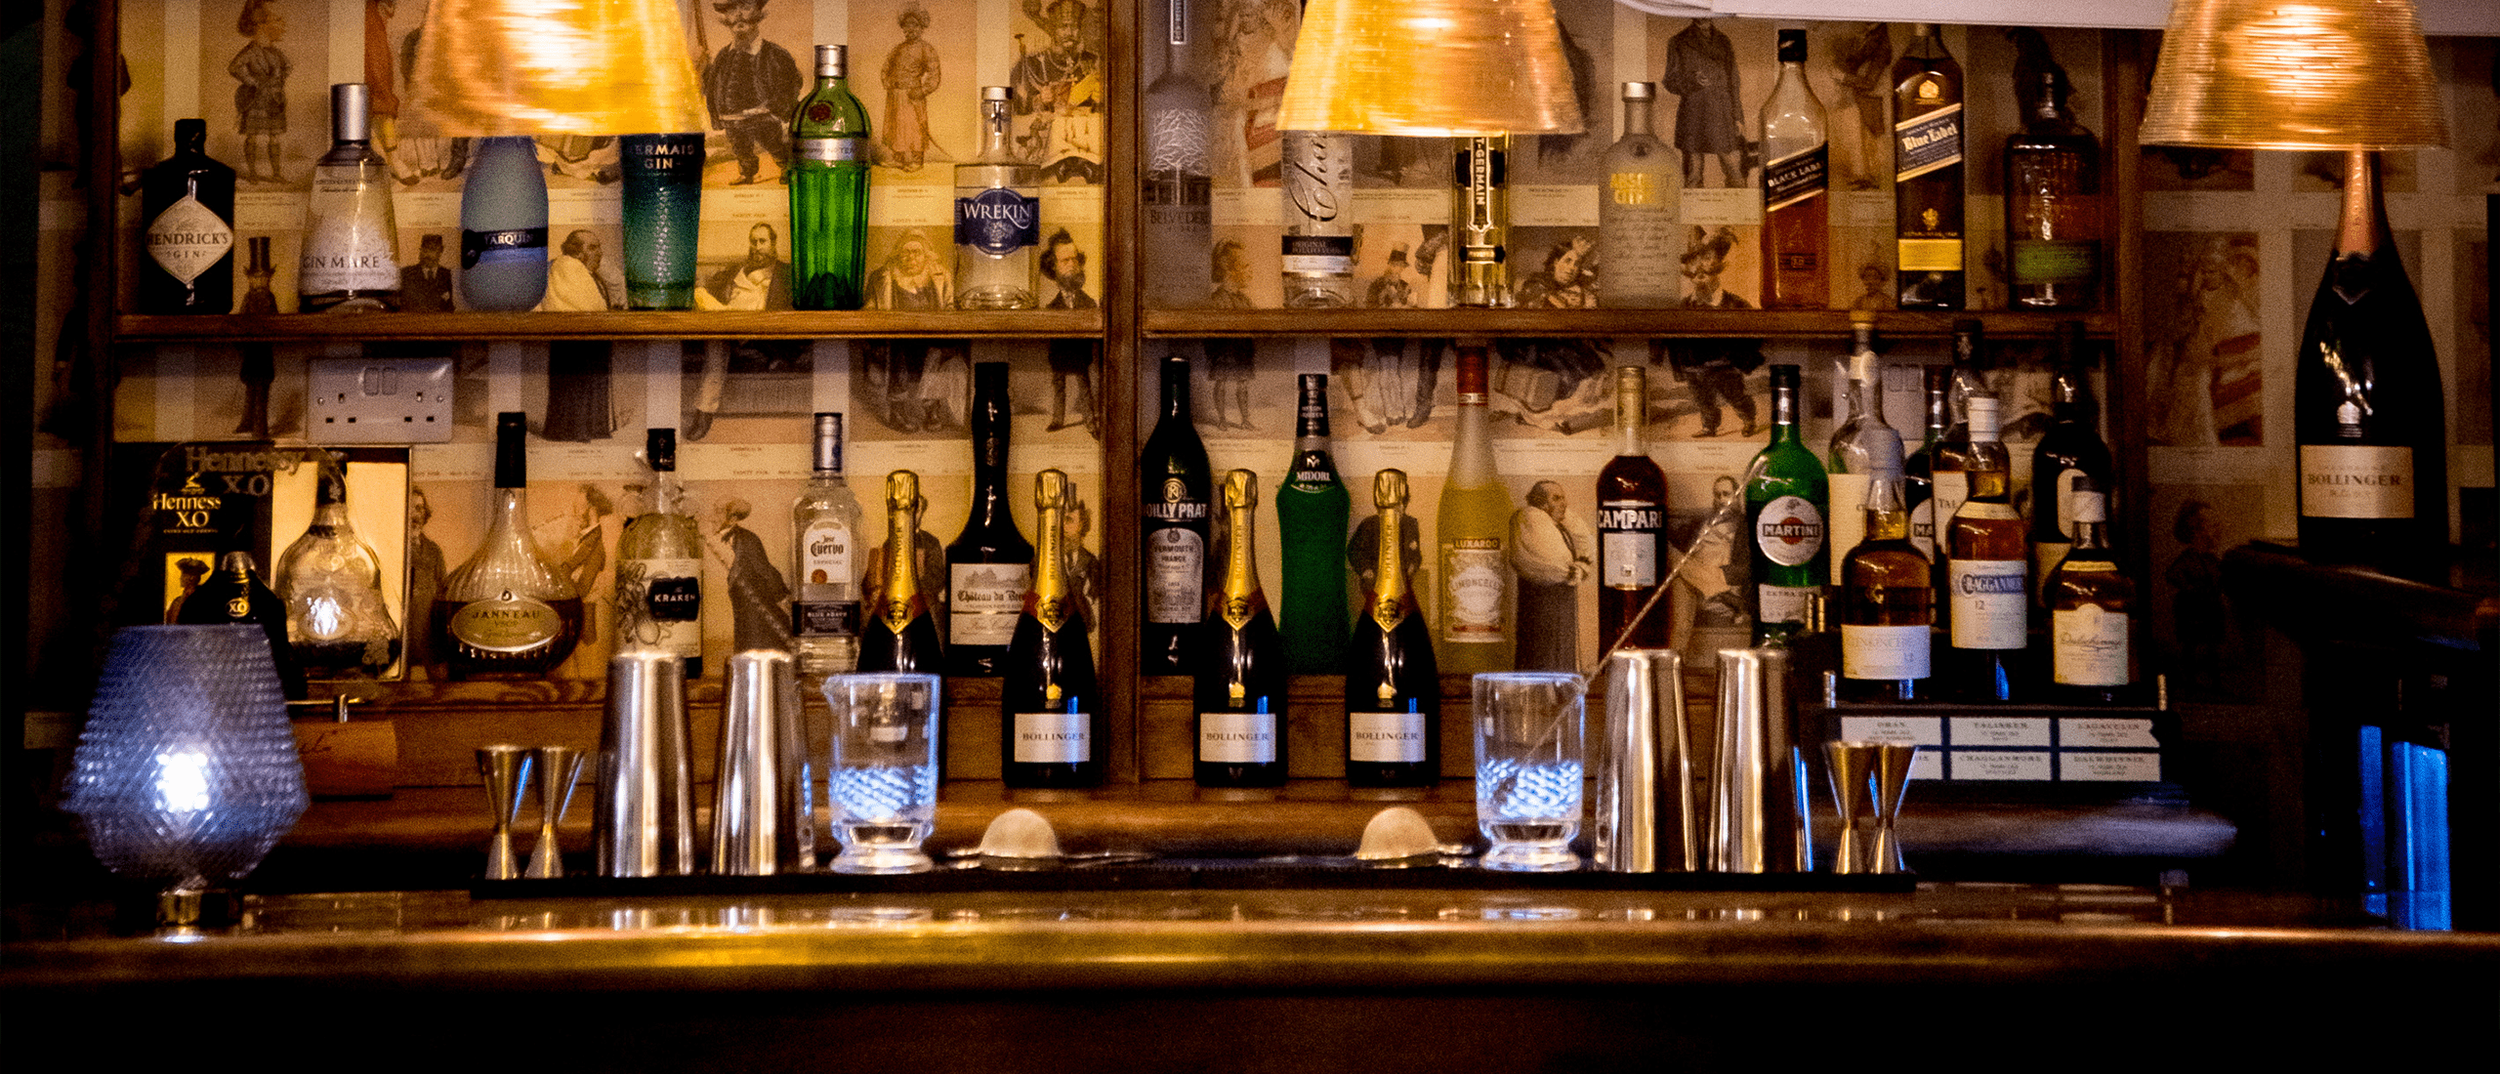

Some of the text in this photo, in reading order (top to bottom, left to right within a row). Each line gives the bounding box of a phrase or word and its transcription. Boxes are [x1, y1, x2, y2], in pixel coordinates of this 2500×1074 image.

[1902, 134, 1929, 151] Blue
[1926, 122, 1959, 142] Label
[644, 158, 674, 170] GIN
[1475, 137, 1486, 206] T-GERMAIN
[963, 202, 1031, 229] WREKIN
[173, 250, 200, 259] GIN
[330, 255, 381, 268] MARE
[1296, 471, 1332, 481] MIDORI
[2307, 474, 2401, 486] BOLLINGER
[152, 492, 222, 510] Henness
[1145, 503, 1207, 518] OILLY PRAT
[1764, 525, 1819, 536] MARTINI
[810, 541, 844, 557] Cuervo
[654, 593, 696, 603] KRAKEN
[471, 610, 541, 619] JANNEAU
[1022, 732, 1085, 741] BOLLINGER
[1206, 732, 1269, 741] BOLLINGER
[1355, 731, 1419, 741] BOLLINGER
